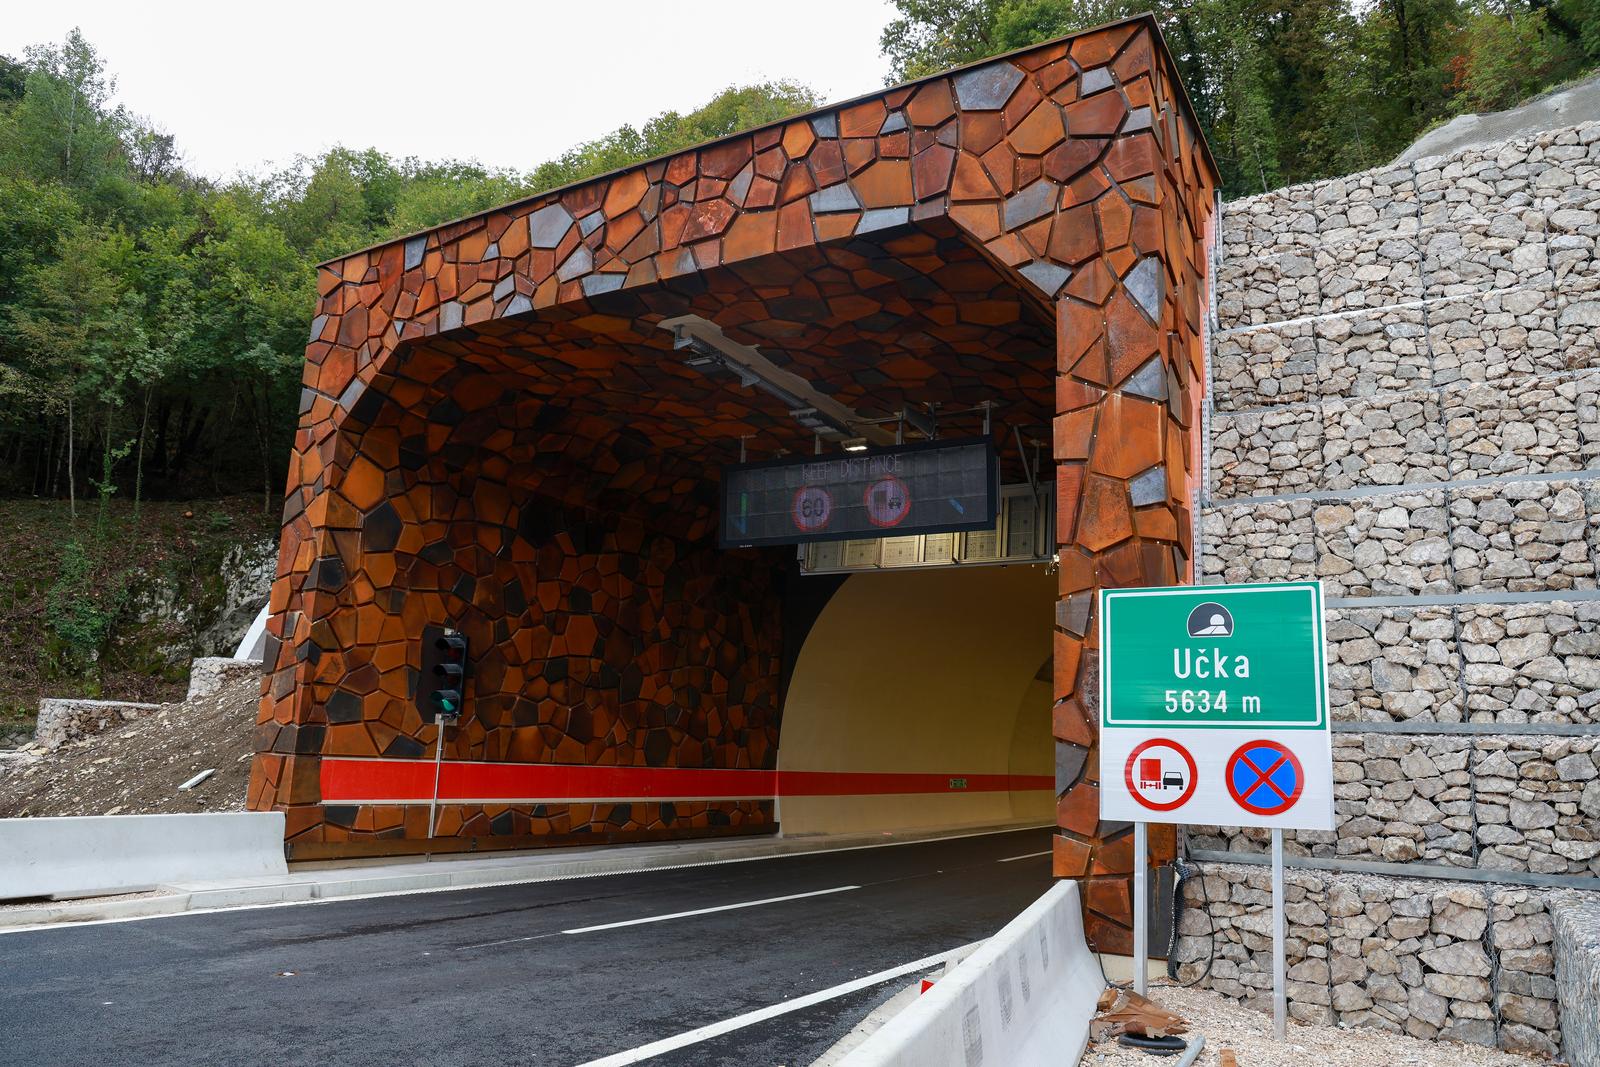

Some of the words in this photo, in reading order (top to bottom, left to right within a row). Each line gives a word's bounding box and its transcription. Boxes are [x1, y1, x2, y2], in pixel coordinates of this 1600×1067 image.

[802, 462, 831, 480] KEEP
[840, 455, 902, 477] DISTANCE
[801, 498, 825, 517] 60
[1174, 648, 1250, 678] Učka
[1165, 690, 1227, 713] 5634
[1242, 695, 1261, 713] m
